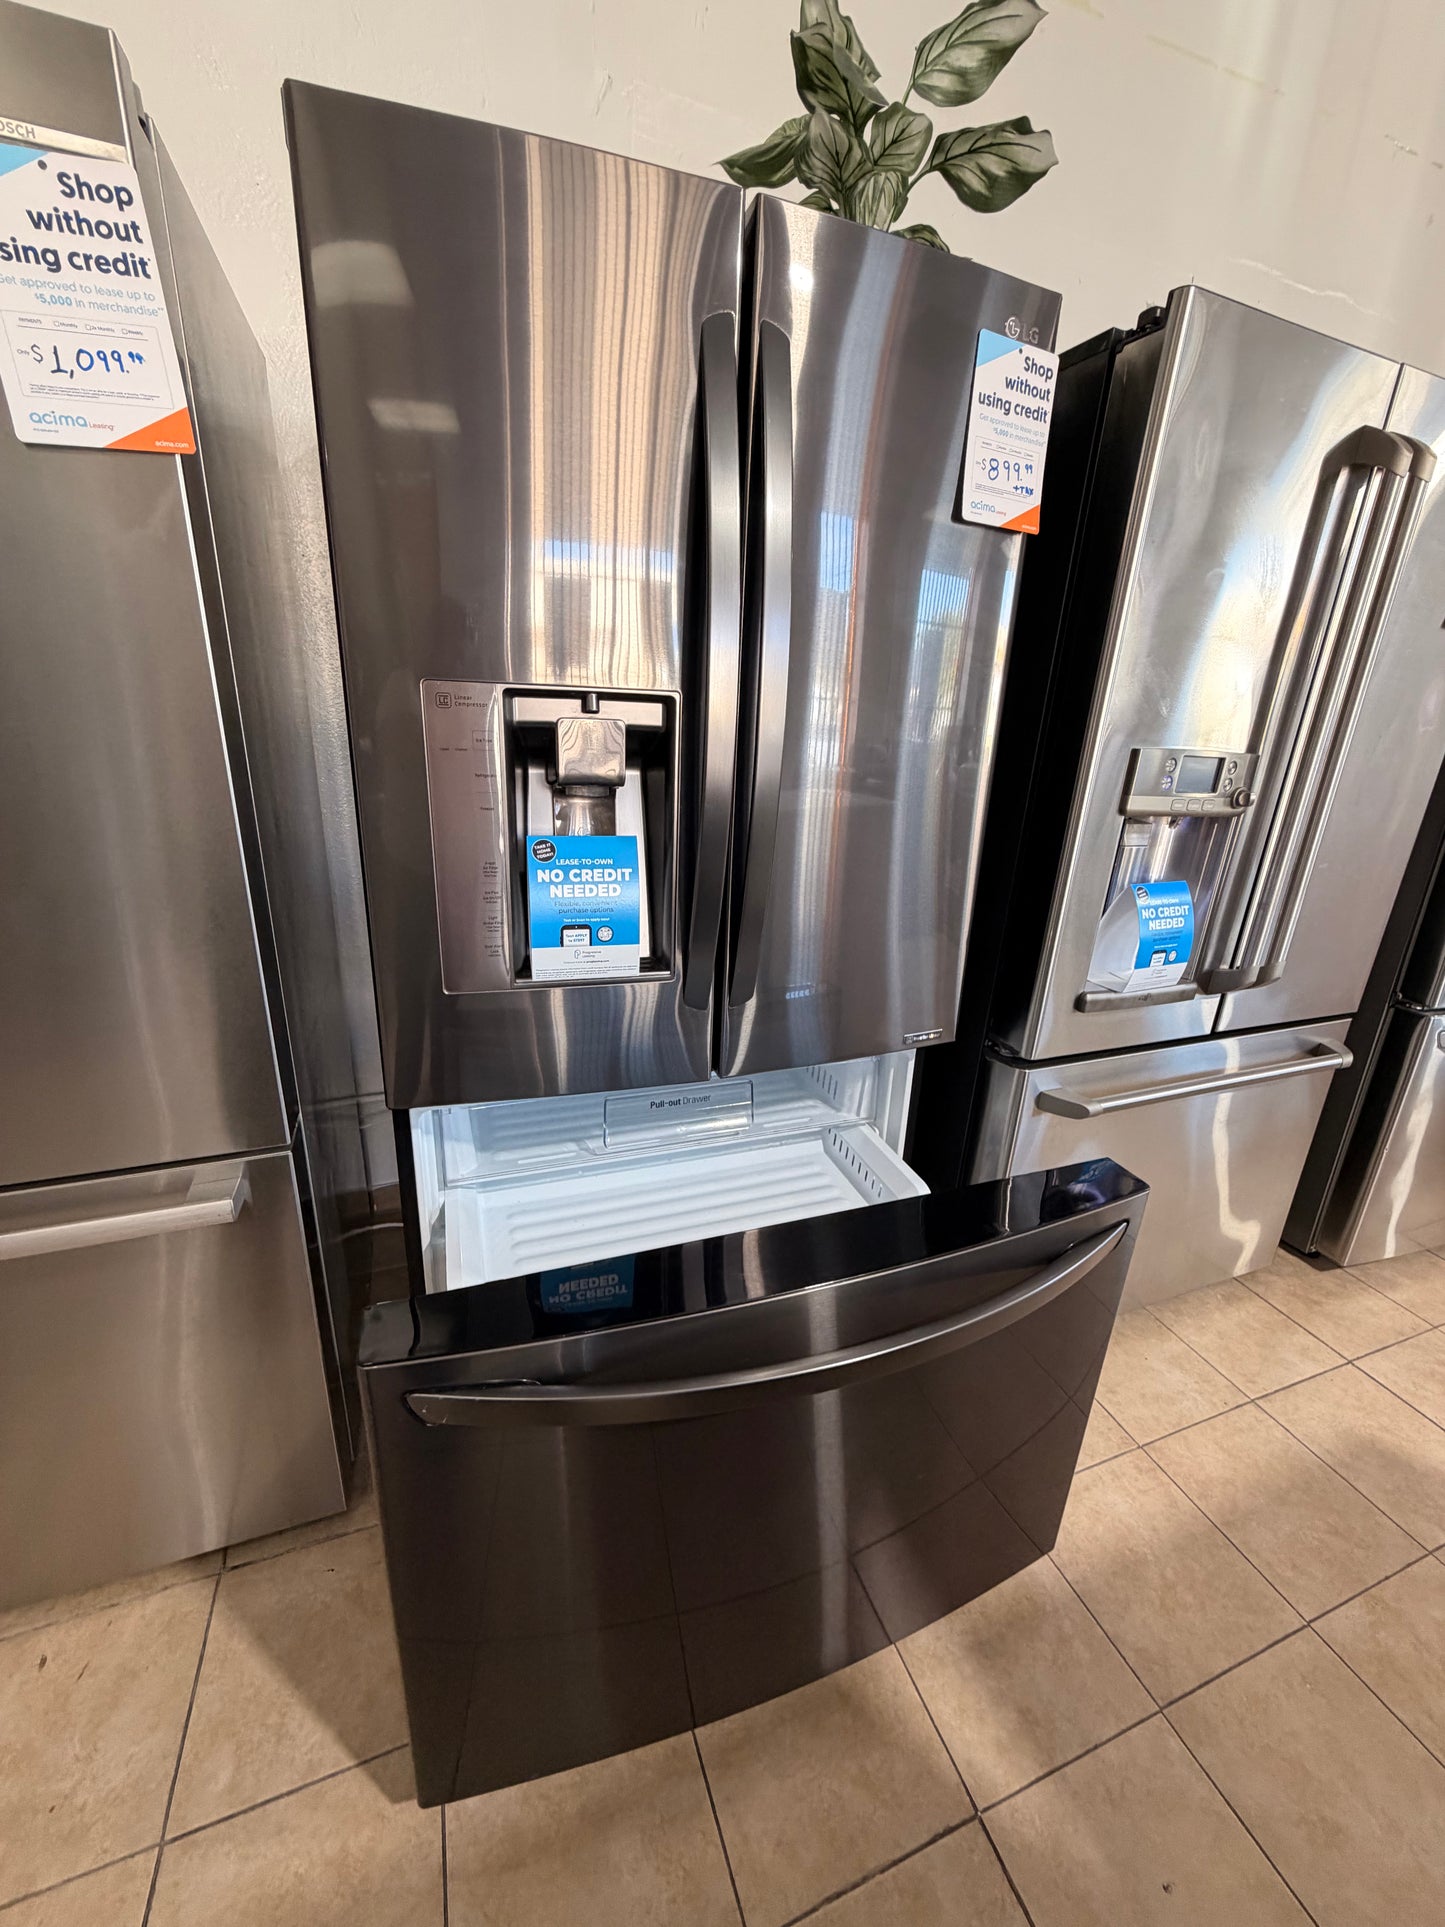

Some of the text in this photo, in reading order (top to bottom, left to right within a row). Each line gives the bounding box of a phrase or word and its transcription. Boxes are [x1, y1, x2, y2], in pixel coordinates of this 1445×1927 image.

[57, 171, 133, 212] Shop
[26, 206, 143, 244] without
[20, 277, 77, 292] approved
[79, 283, 92, 294] to
[94, 284, 124, 298] lease
[127, 290, 141, 302] up
[143, 291, 155, 302] to
[35, 293, 72, 306] $5,000
[74, 297, 85, 308] in
[1022, 323, 1039, 344] LG
[1024, 356, 1053, 382] Shop
[1005, 376, 1050, 403] without
[978, 391, 1012, 416] using
[29, 410, 114, 431] acima Leasing
[990, 417, 1013, 429] approved
[970, 500, 996, 513] acima
[556, 858, 613, 866] LEASE-TO-OWN
[537, 868, 633, 883] NO CREDIT
[549, 884, 622, 898] NEEDED
[558, 905, 614, 915] purchase options
[1141, 905, 1190, 919] NO CREDIT
[1149, 917, 1185, 930] NEEDED
[650, 1094, 711, 1109] Pull-out Drawer
